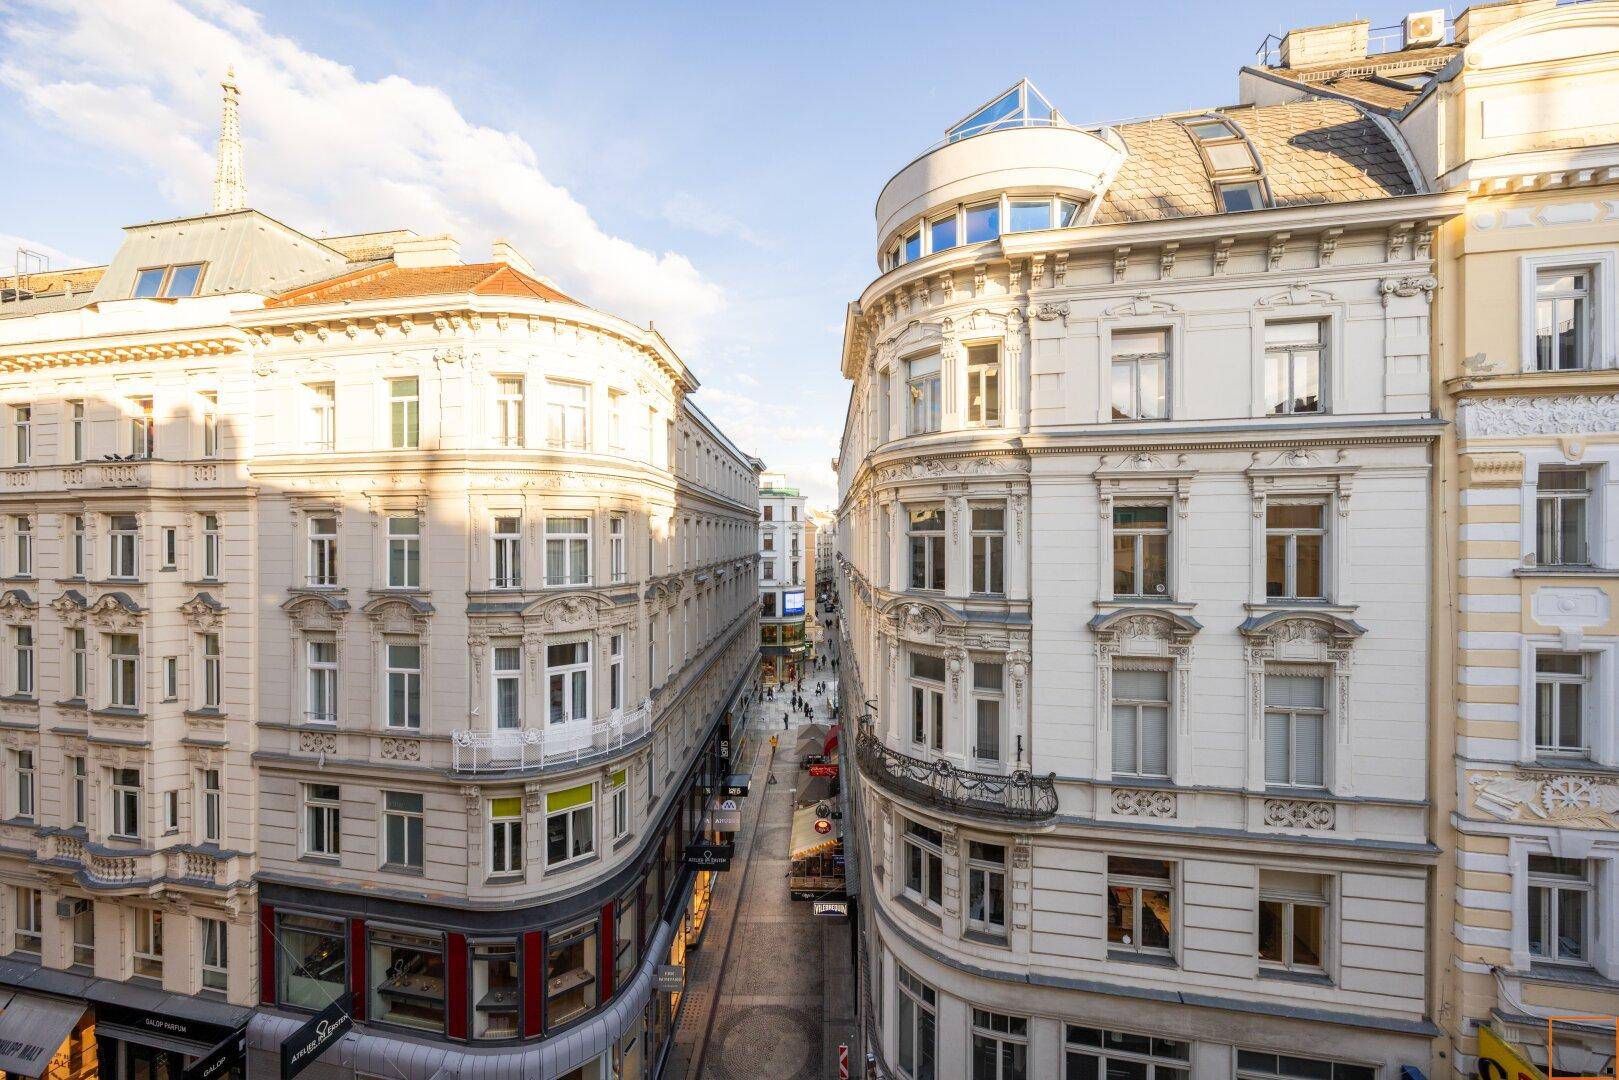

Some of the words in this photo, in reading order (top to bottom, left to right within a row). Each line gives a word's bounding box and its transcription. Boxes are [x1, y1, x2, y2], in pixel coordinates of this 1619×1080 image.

[145, 1018, 164, 1028] GALOP
[164, 1022, 187, 1033] PARFUM
[290, 1039, 317, 1064] ATELIER
[327, 1013, 349, 1035] ERSTEN
[203, 1056, 226, 1077] GALOP
